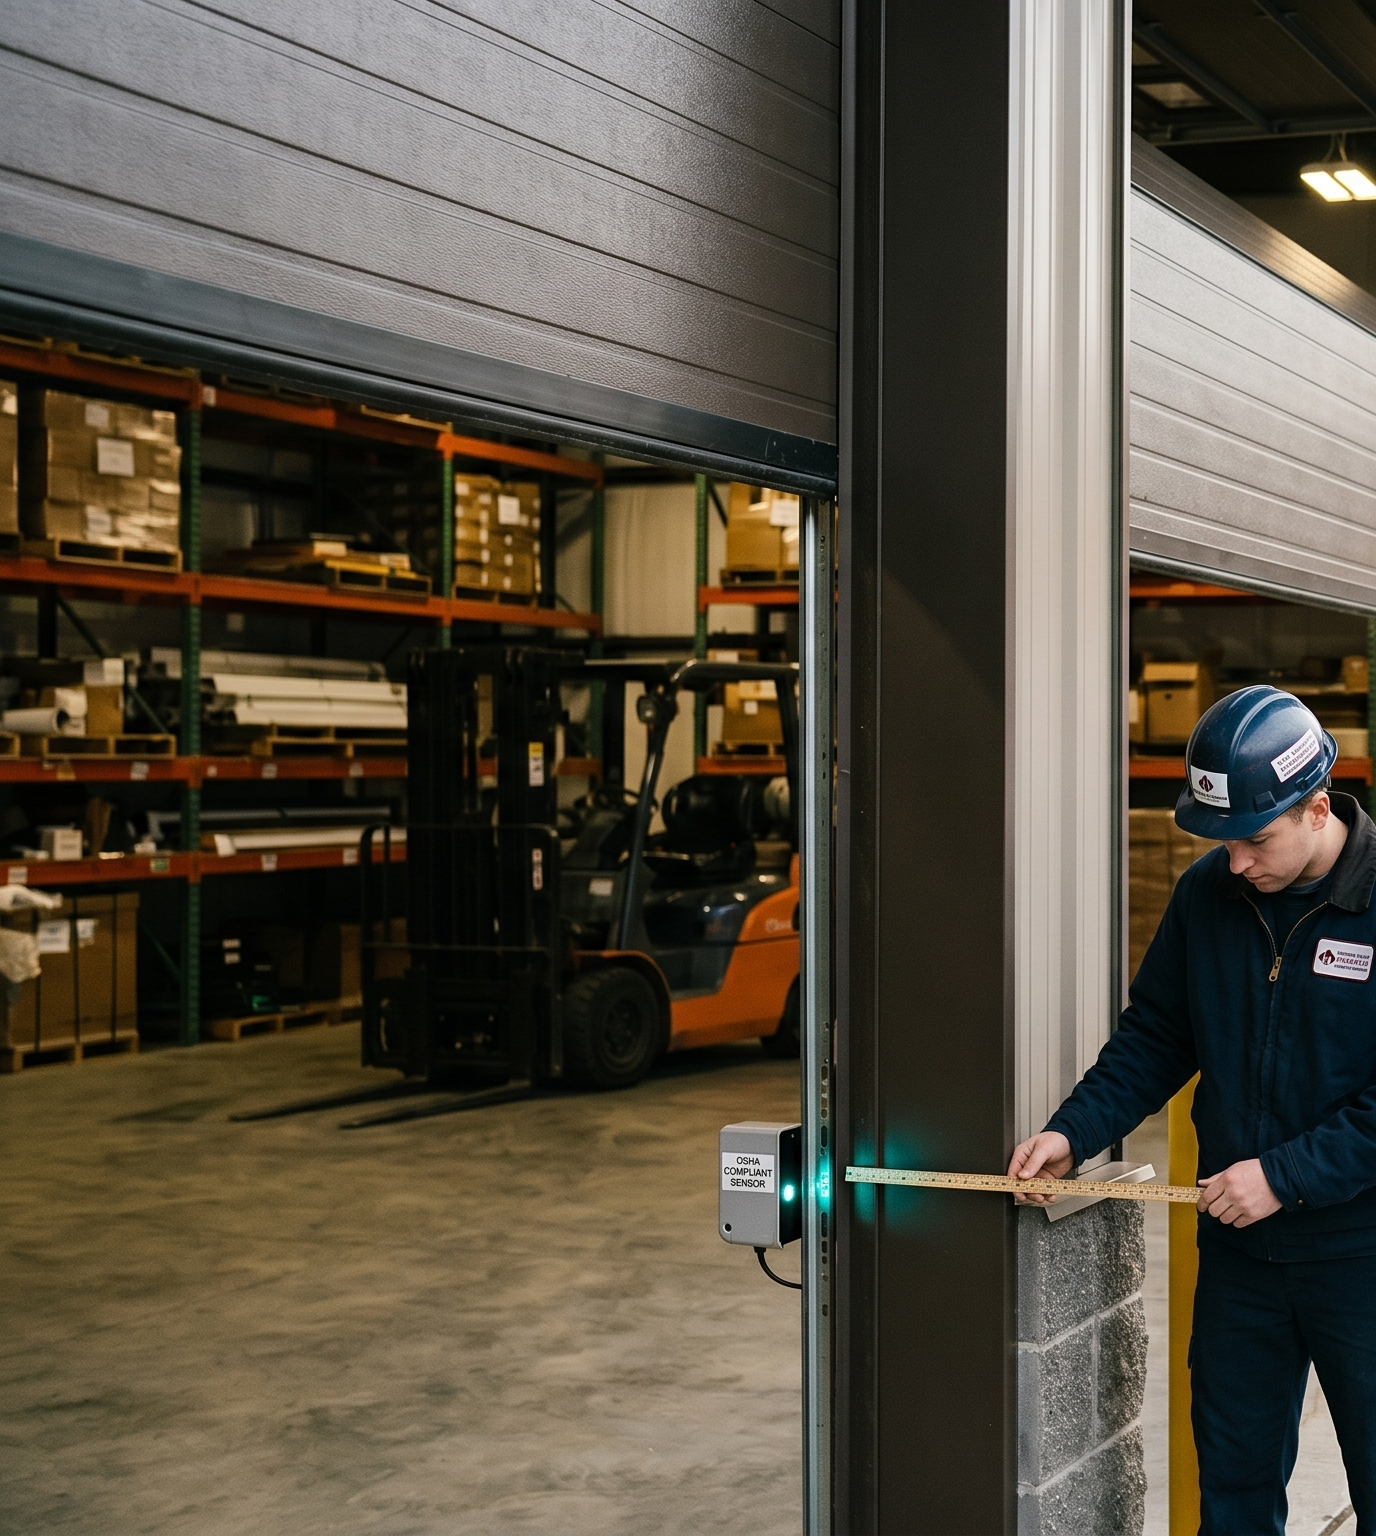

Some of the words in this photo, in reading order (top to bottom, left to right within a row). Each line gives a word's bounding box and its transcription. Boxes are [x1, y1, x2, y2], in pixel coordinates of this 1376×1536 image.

[736, 1156, 760, 1166] OSHA
[723, 1166, 772, 1177] COMPLIANT
[730, 1178, 766, 1188] SENSOR
